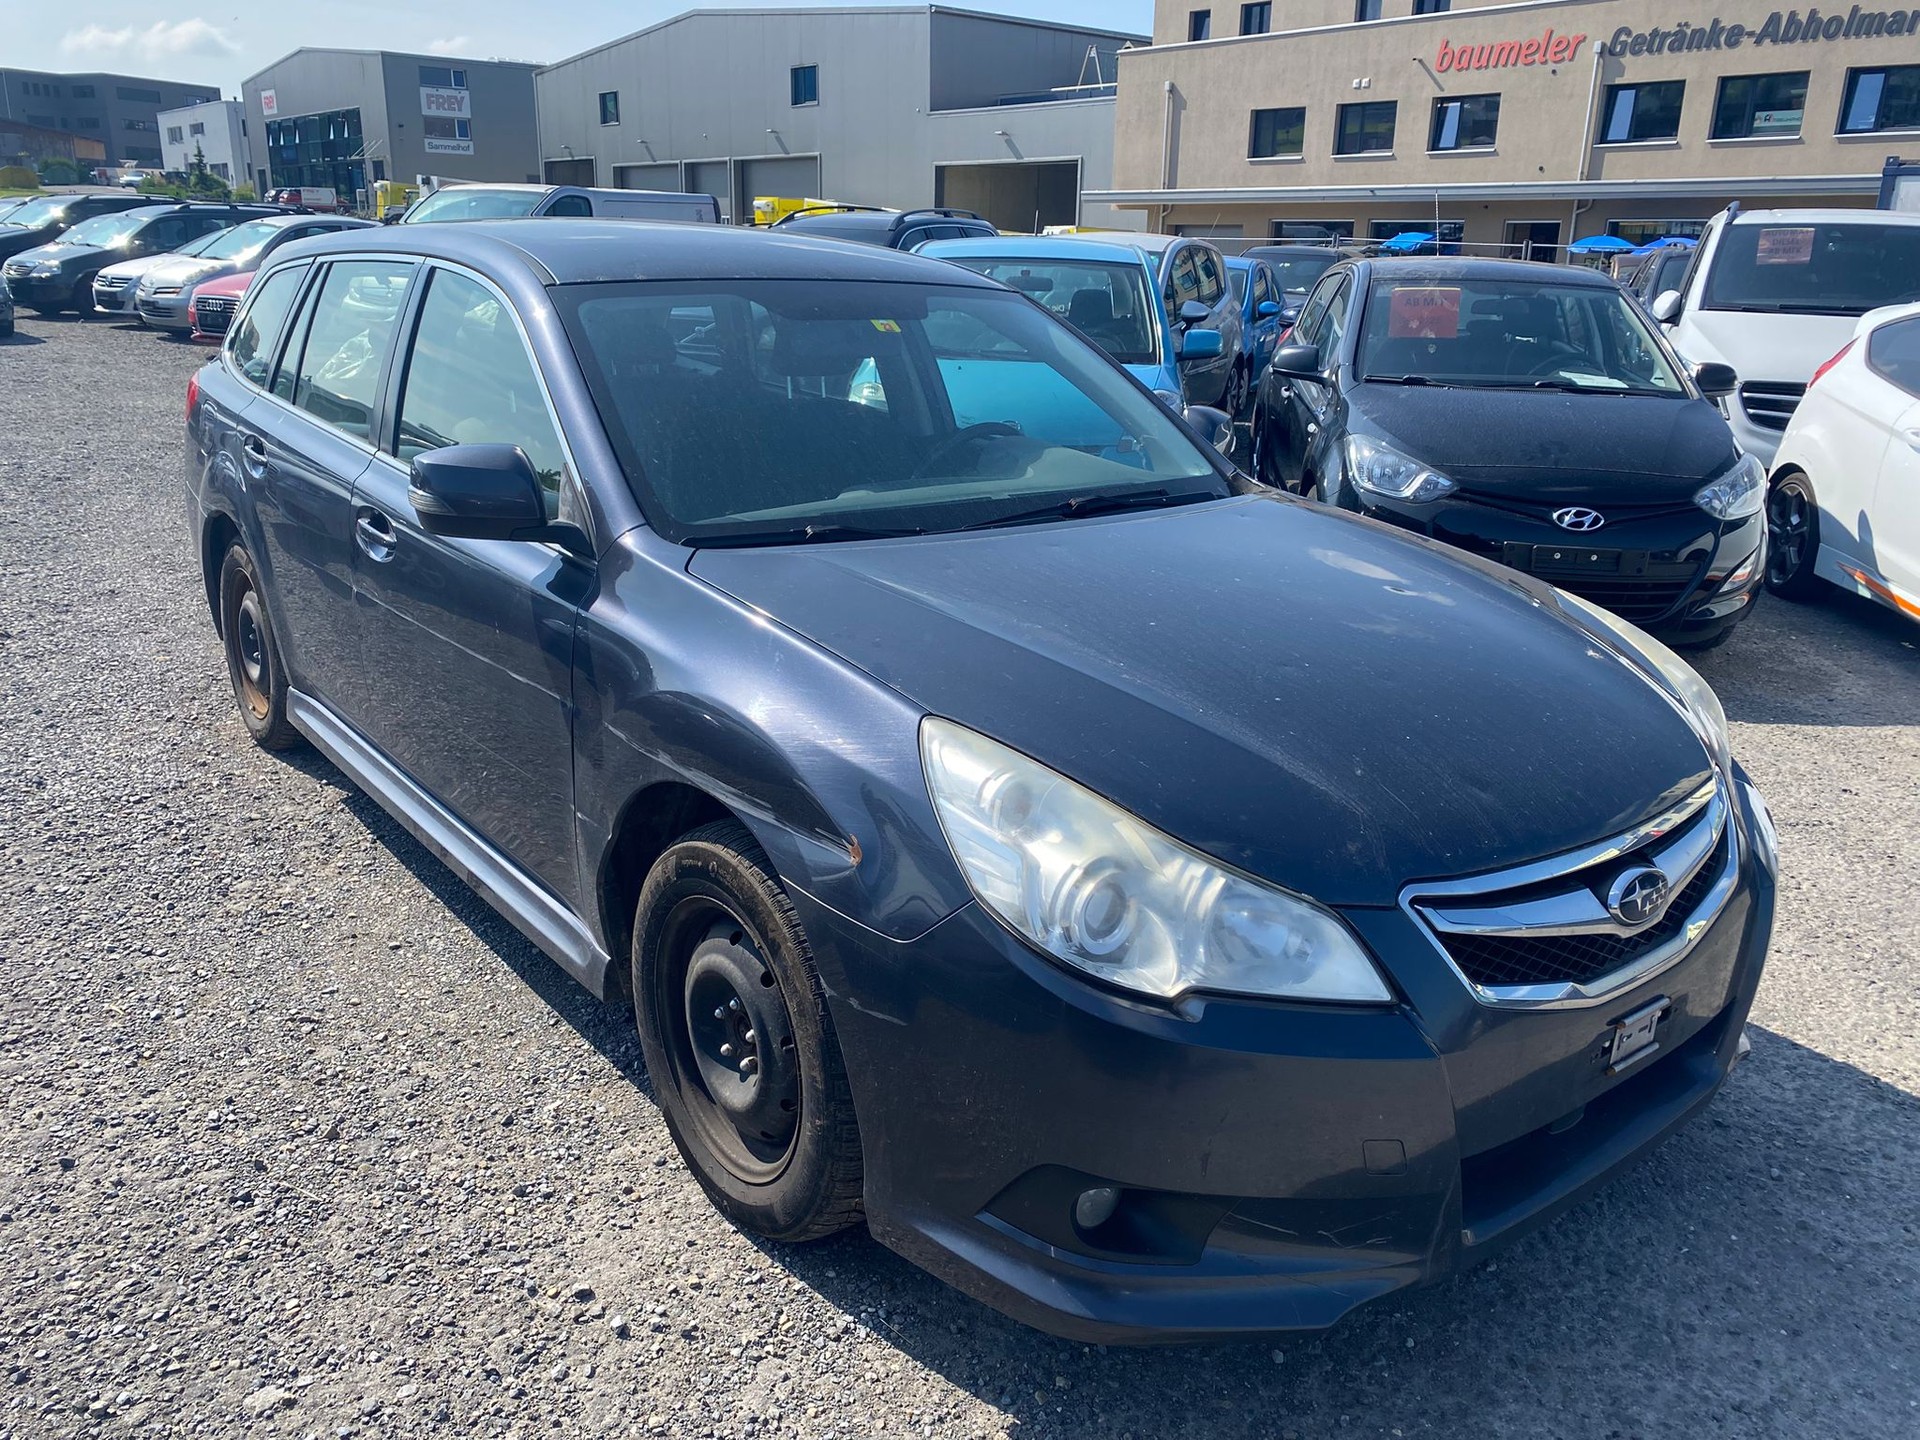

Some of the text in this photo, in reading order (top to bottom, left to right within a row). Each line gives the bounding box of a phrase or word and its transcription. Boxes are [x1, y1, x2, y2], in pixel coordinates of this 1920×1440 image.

[1434, 28, 1587, 73] baumeler
[425, 92, 465, 112] FREY
[427, 141, 471, 152] Sammelhof
